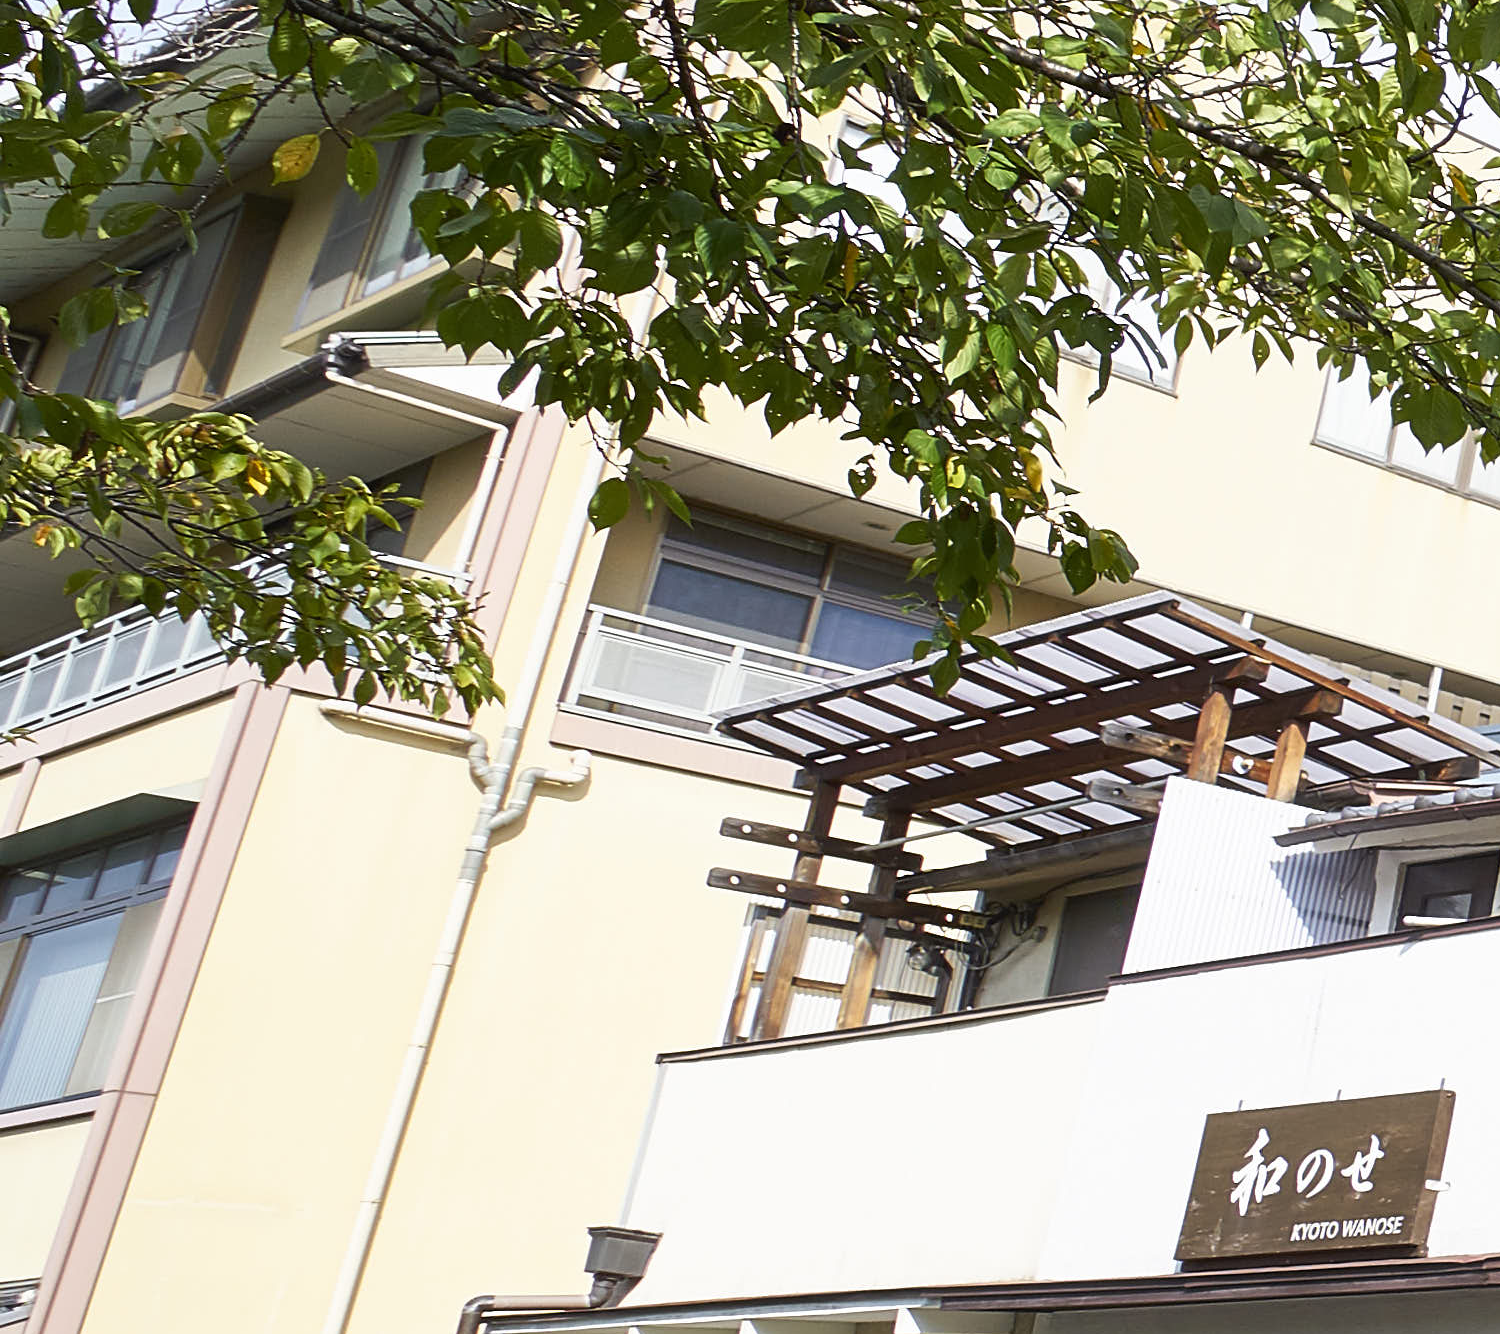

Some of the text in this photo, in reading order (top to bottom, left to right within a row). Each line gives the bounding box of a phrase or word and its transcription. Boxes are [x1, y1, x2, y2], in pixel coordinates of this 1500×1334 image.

[1229, 1128, 1385, 1217] 和のせ
[1290, 1215, 1404, 1242] KYOTO WANOSE
